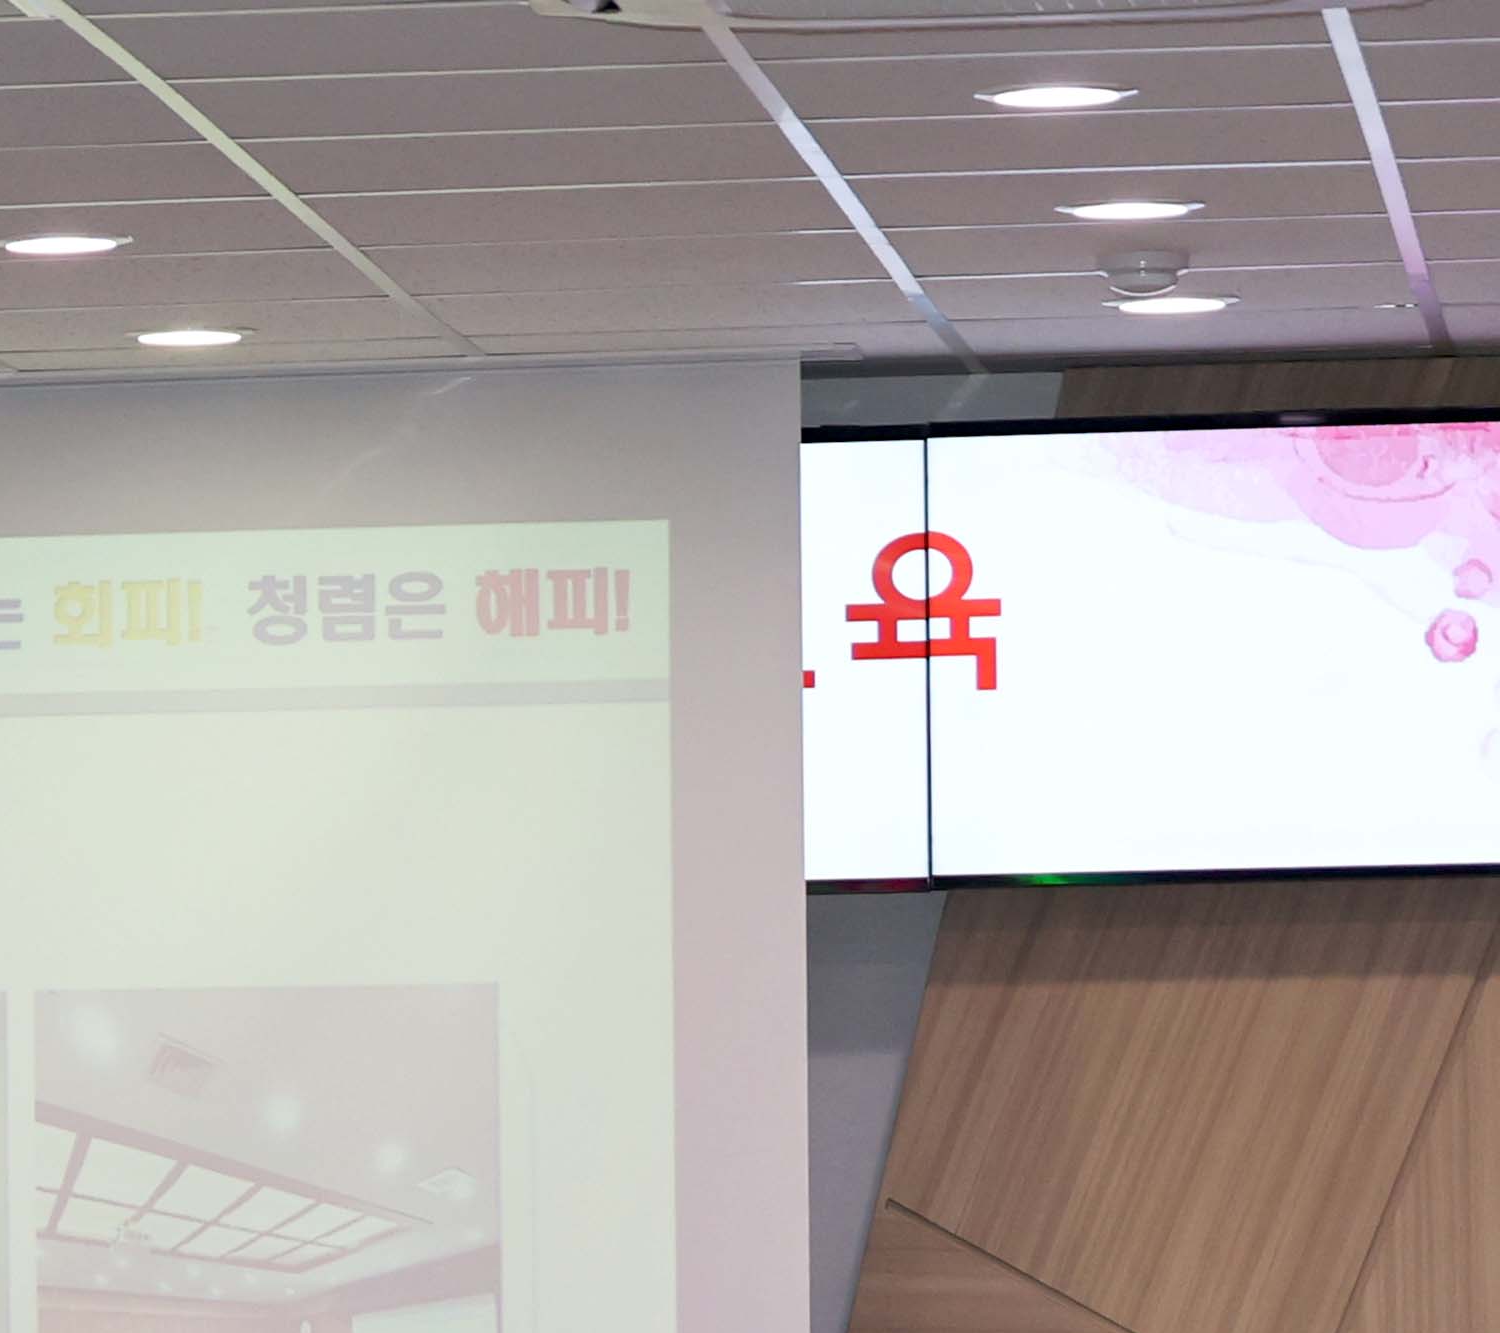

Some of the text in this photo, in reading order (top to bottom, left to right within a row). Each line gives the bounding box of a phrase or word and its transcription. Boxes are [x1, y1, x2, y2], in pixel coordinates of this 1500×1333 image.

[51, 576, 204, 649] 회피!
[246, 570, 448, 646] 청렴은
[475, 565, 632, 638] 해피!
[802, 531, 1000, 690] 육
